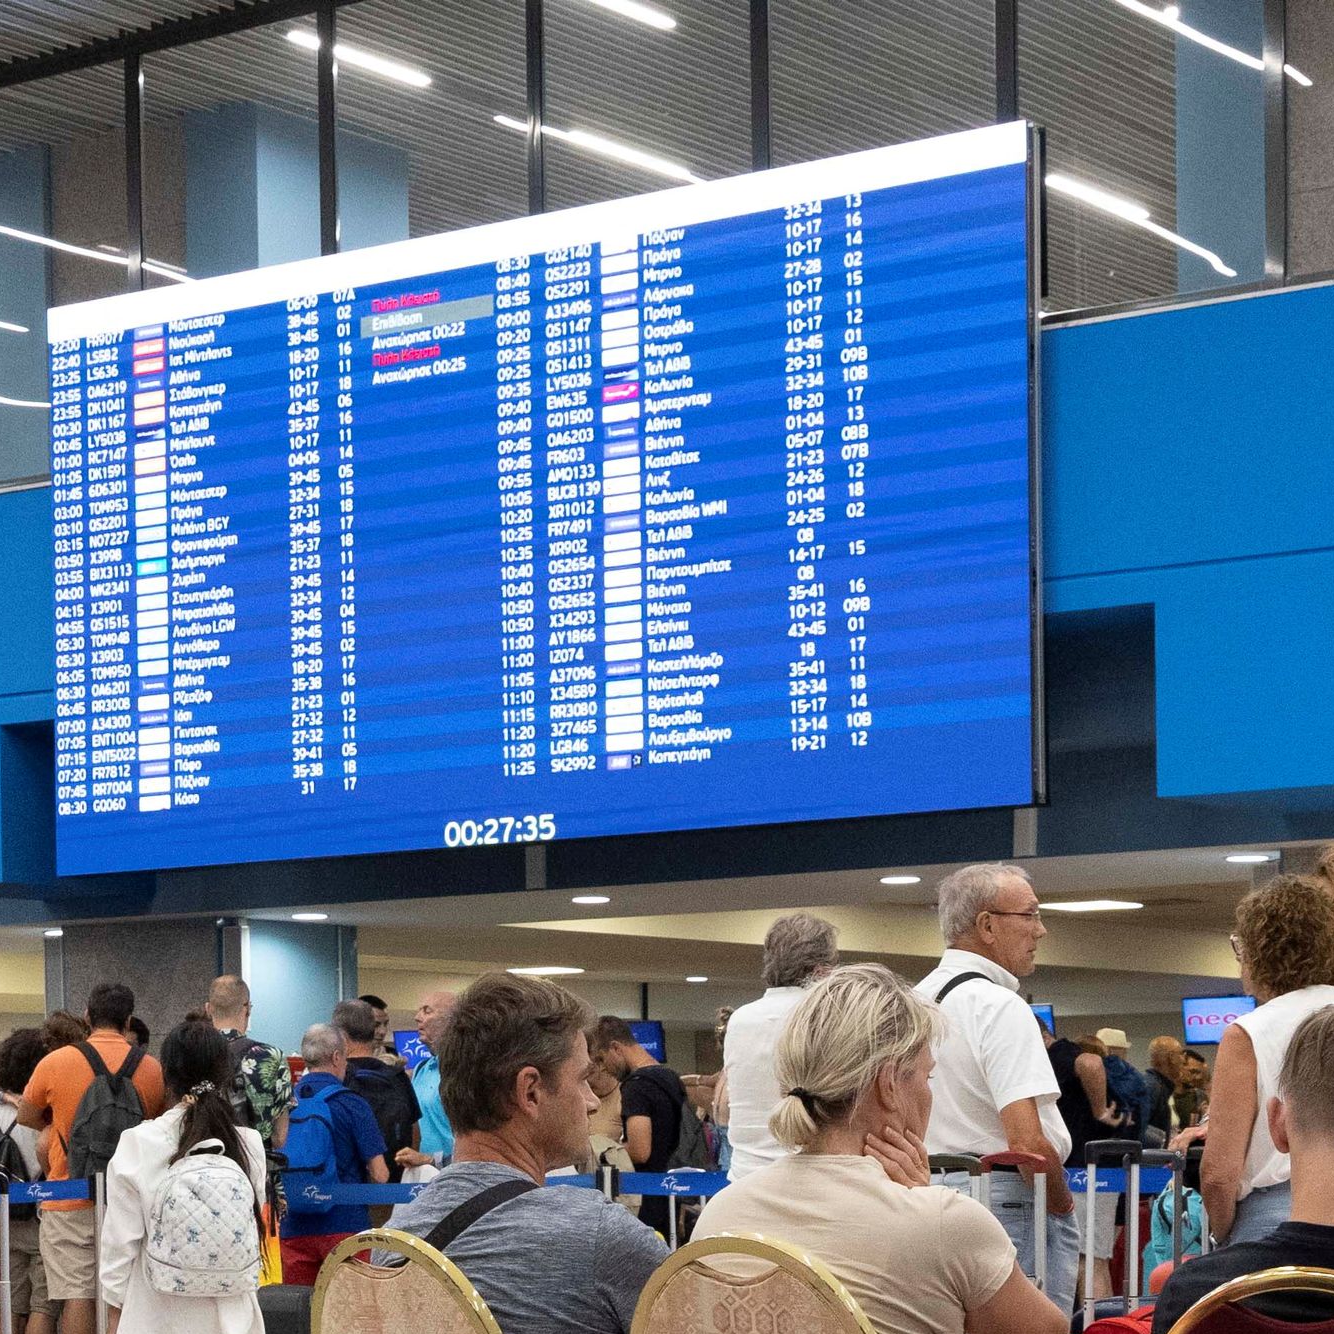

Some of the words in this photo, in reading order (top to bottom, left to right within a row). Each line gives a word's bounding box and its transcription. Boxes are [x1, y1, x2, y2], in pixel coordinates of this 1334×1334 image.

[496, 272, 531, 292] 08:40
[785, 217, 822, 239] 10-17
[496, 290, 531, 309] 08:55
[496, 327, 531, 347] 09:20
[786, 276, 823, 297] 10-17
[496, 309, 531, 329] 09:00
[496, 363, 531, 382] 09:25
[846, 308, 863, 324] 12
[51, 353, 81, 372] 22:40
[496, 345, 531, 365] 09:25
[53, 388, 82, 408] 23:55
[432, 321, 465, 340] 00:22
[52, 370, 81, 388] 23:25
[52, 404, 82, 422] 23:55
[289, 363, 319, 382] 10-17
[338, 358, 351, 373] 11
[52, 420, 83, 438] 00:30
[289, 380, 319, 399] 10-17
[432, 356, 467, 375] 00:25
[496, 381, 532, 400] 09:35
[497, 399, 532, 418] 09:40
[497, 416, 532, 436] 09:40
[52, 437, 82, 455] 00:45
[497, 436, 532, 455] 09:45
[53, 453, 83, 471] 01:00
[497, 454, 533, 473] 09:45
[53, 469, 83, 487] 01:05
[498, 472, 533, 491] 09:55
[53, 486, 83, 503] 01:45
[499, 490, 533, 508] 10:05
[500, 508, 533, 526] 10:20
[786, 467, 825, 487] 24-26
[848, 461, 865, 478] 12
[53, 504, 83, 521] 03:00
[53, 520, 84, 537] 03:10
[500, 525, 533, 544] 10:25
[54, 537, 84, 554] 03:15
[500, 545, 533, 563] 10:35
[54, 553, 84, 570] 03:50
[501, 580, 534, 598] 10:40
[788, 544, 825, 563] 14-17
[848, 539, 866, 555] 15
[54, 569, 84, 586] 03:55
[500, 563, 534, 580] 10:40
[54, 585, 85, 602] 04:00
[55, 619, 85, 636] 04:55
[341, 585, 355, 601] 12
[55, 603, 85, 620] 04:15
[501, 616, 534, 633] 10:50
[849, 577, 866, 593] 16
[501, 598, 534, 616] 10:50
[501, 634, 535, 651] 11:00
[789, 600, 826, 620] 10-12
[55, 636, 85, 653] 05:30
[55, 652, 85, 669] 05:30
[502, 652, 535, 669] 11:00
[56, 669, 86, 685] 06:05
[502, 671, 535, 688] 11:05
[56, 685, 86, 701] 06:30
[502, 689, 535, 706] 11:10
[56, 701, 86, 717] 06:45
[502, 707, 536, 724] 11:15
[56, 719, 86, 735] 07:00
[502, 725, 535, 741] 11:20
[790, 696, 827, 714] 15-17
[57, 735, 87, 751] 07:05
[503, 742, 536, 759] 11:20
[57, 751, 87, 767] 07:15
[503, 760, 536, 777] 11:25
[791, 734, 826, 752] 19-21
[851, 730, 868, 747] 12
[57, 768, 87, 783] 07:20
[57, 784, 87, 800] 07:45
[58, 800, 88, 816] 08:30
[301, 780, 315, 795] 31
[343, 776, 357, 791] 17
[444, 813, 556, 848] 00:27:35
[1188, 1012, 1239, 1026] neo
